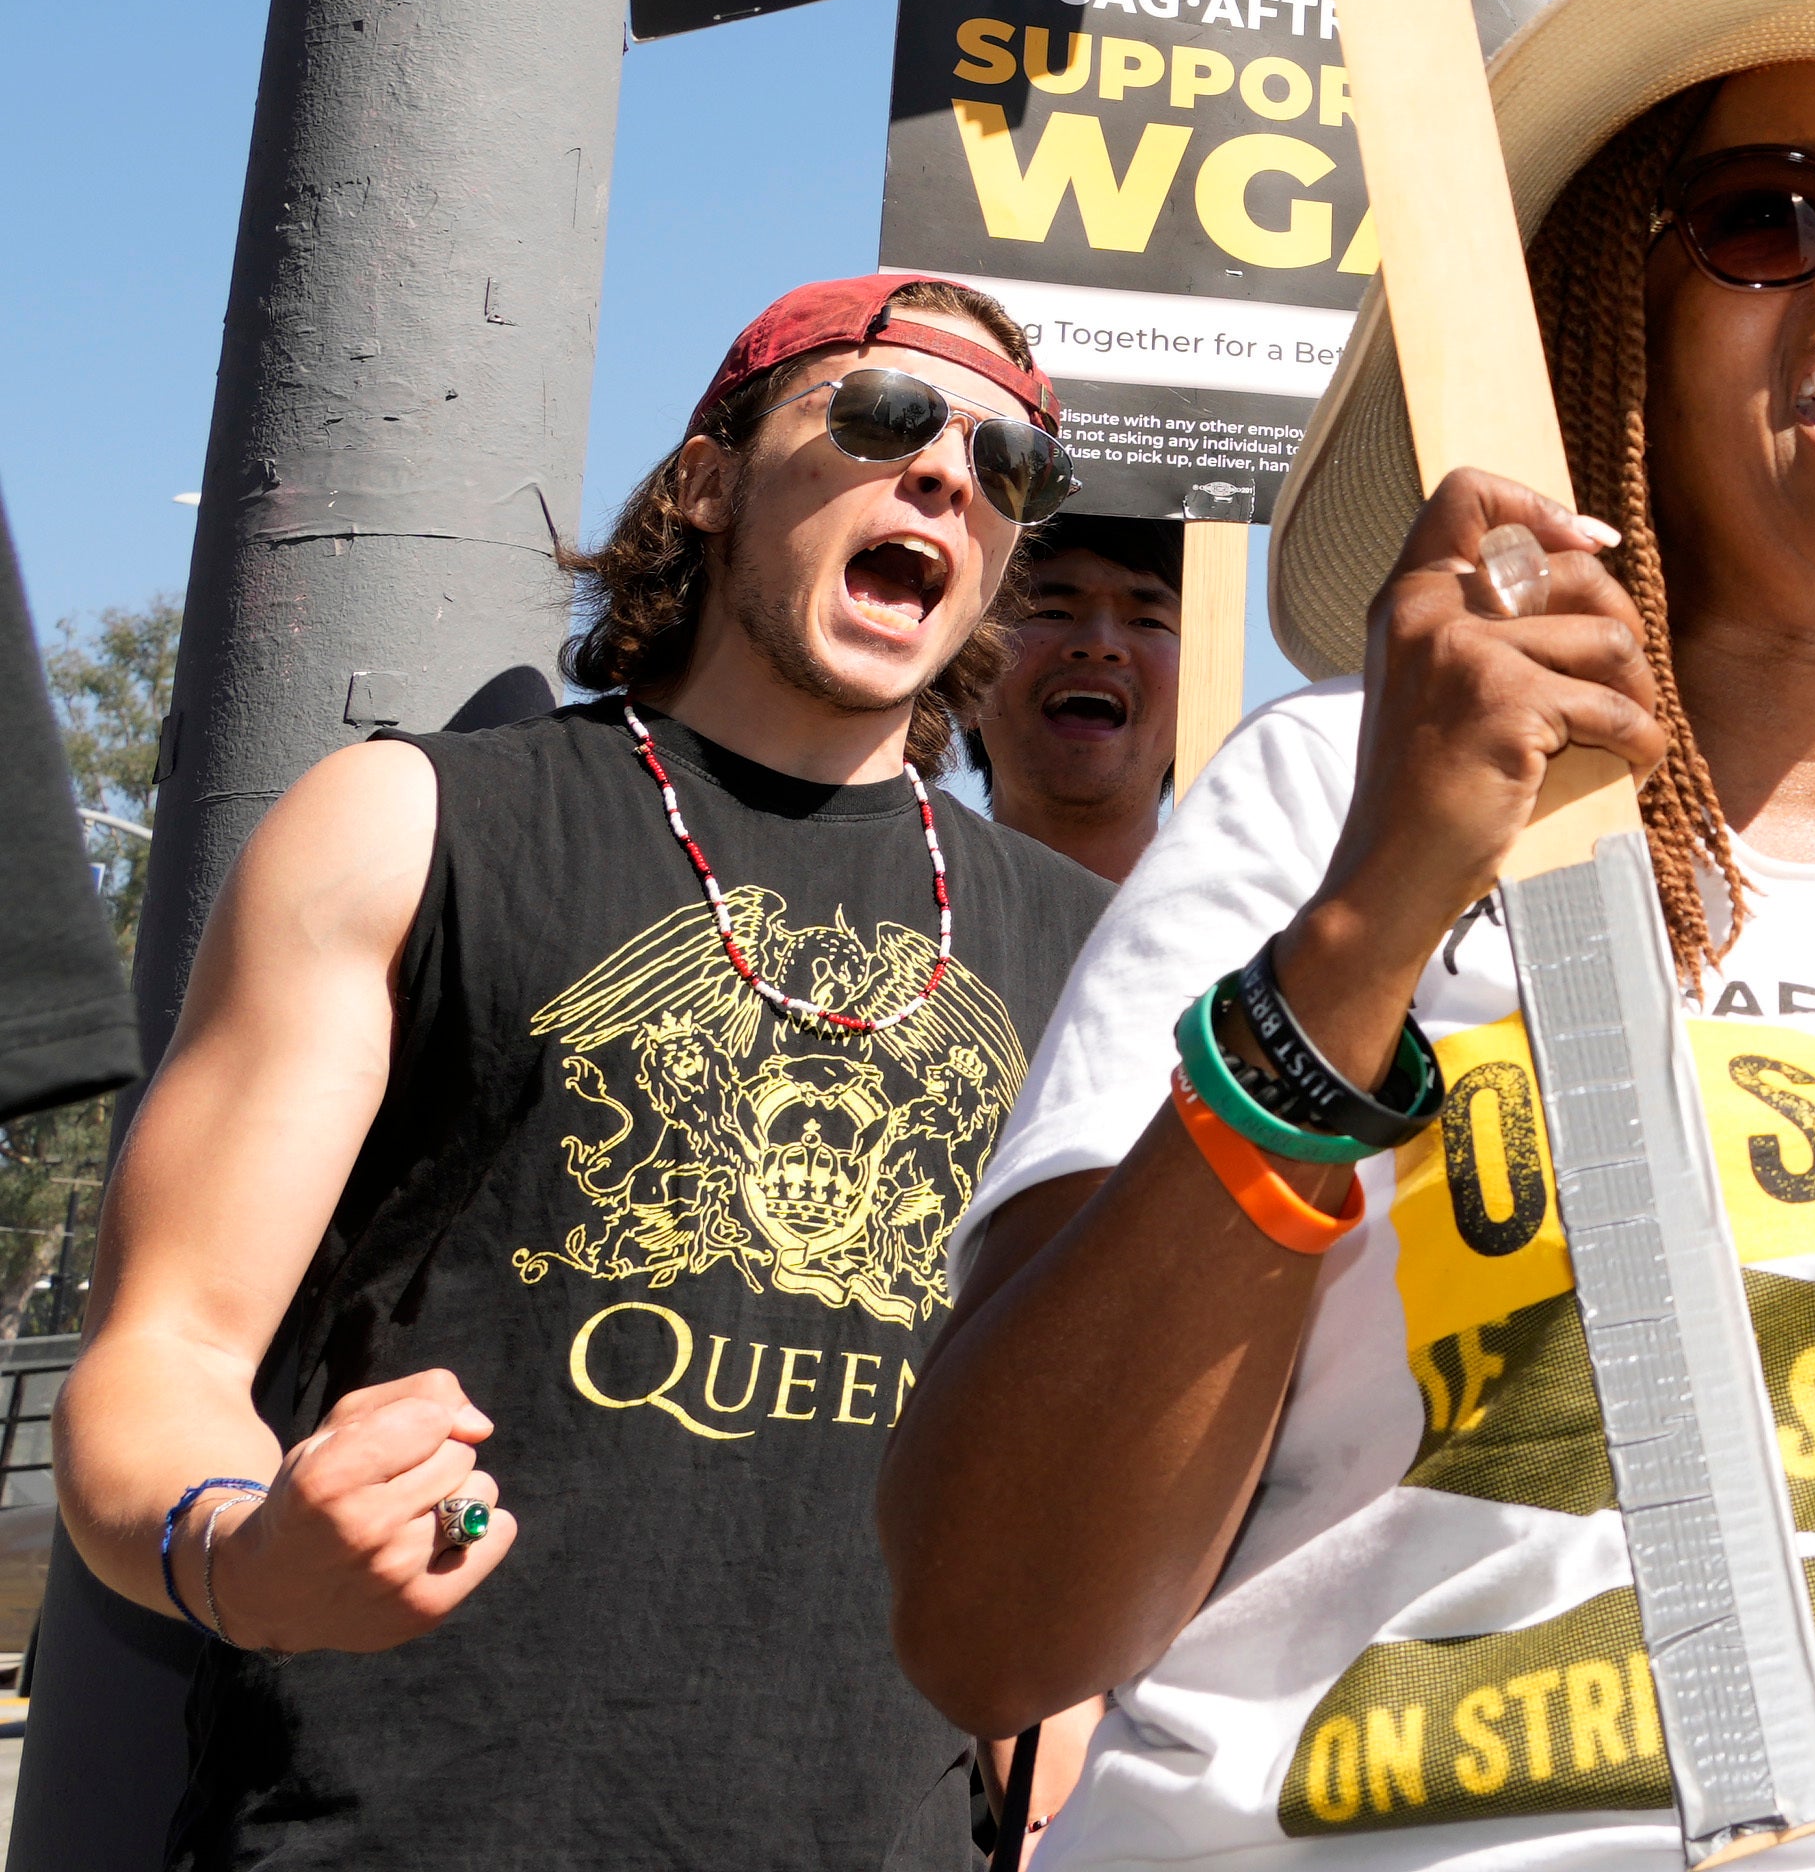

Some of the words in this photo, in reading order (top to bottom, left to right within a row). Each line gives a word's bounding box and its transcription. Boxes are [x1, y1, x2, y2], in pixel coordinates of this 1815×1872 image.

[1054, 320, 1204, 354] Together
[1214, 332, 1257, 358] for
[1267, 343, 1283, 361] a
[1058, 424, 1073, 440] is
[1076, 427, 1105, 443] not
[1109, 430, 1164, 450] asking
[1168, 434, 1199, 450] any
[1202, 436, 1283, 456] individual
[1123, 413, 1161, 430] with
[1165, 419, 1196, 434] any
[1199, 419, 1245, 435] other
[1105, 448, 1123, 461] to
[1127, 449, 1162, 466] pick
[1166, 453, 1193, 468] up,
[1197, 454, 1256, 473] deliver,
[1273, 1039, 1344, 1107] JUST
[1441, 1060, 1547, 1258] O
[1306, 1703, 1428, 1823] ON
